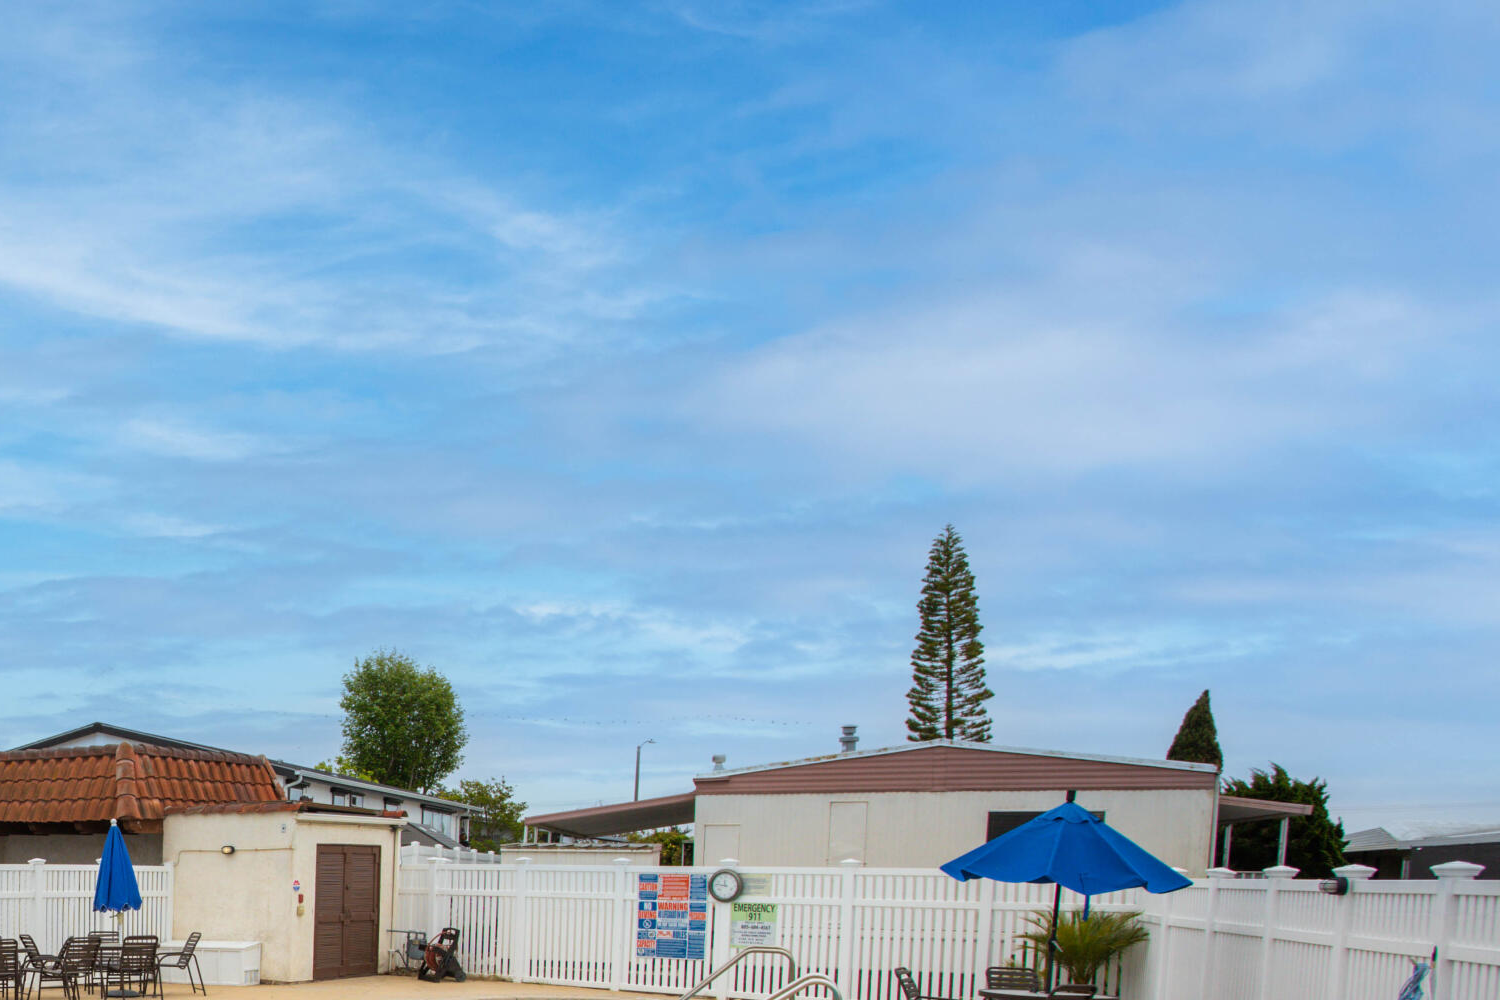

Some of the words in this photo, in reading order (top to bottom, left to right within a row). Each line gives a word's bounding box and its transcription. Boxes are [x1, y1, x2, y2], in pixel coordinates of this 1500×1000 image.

[658, 903, 688, 911] WARNING
[733, 904, 775, 912] EMERGENCY
[638, 911, 656, 919] DIVING
[748, 913, 761, 921] 911
[637, 940, 655, 948] CAPACITY
